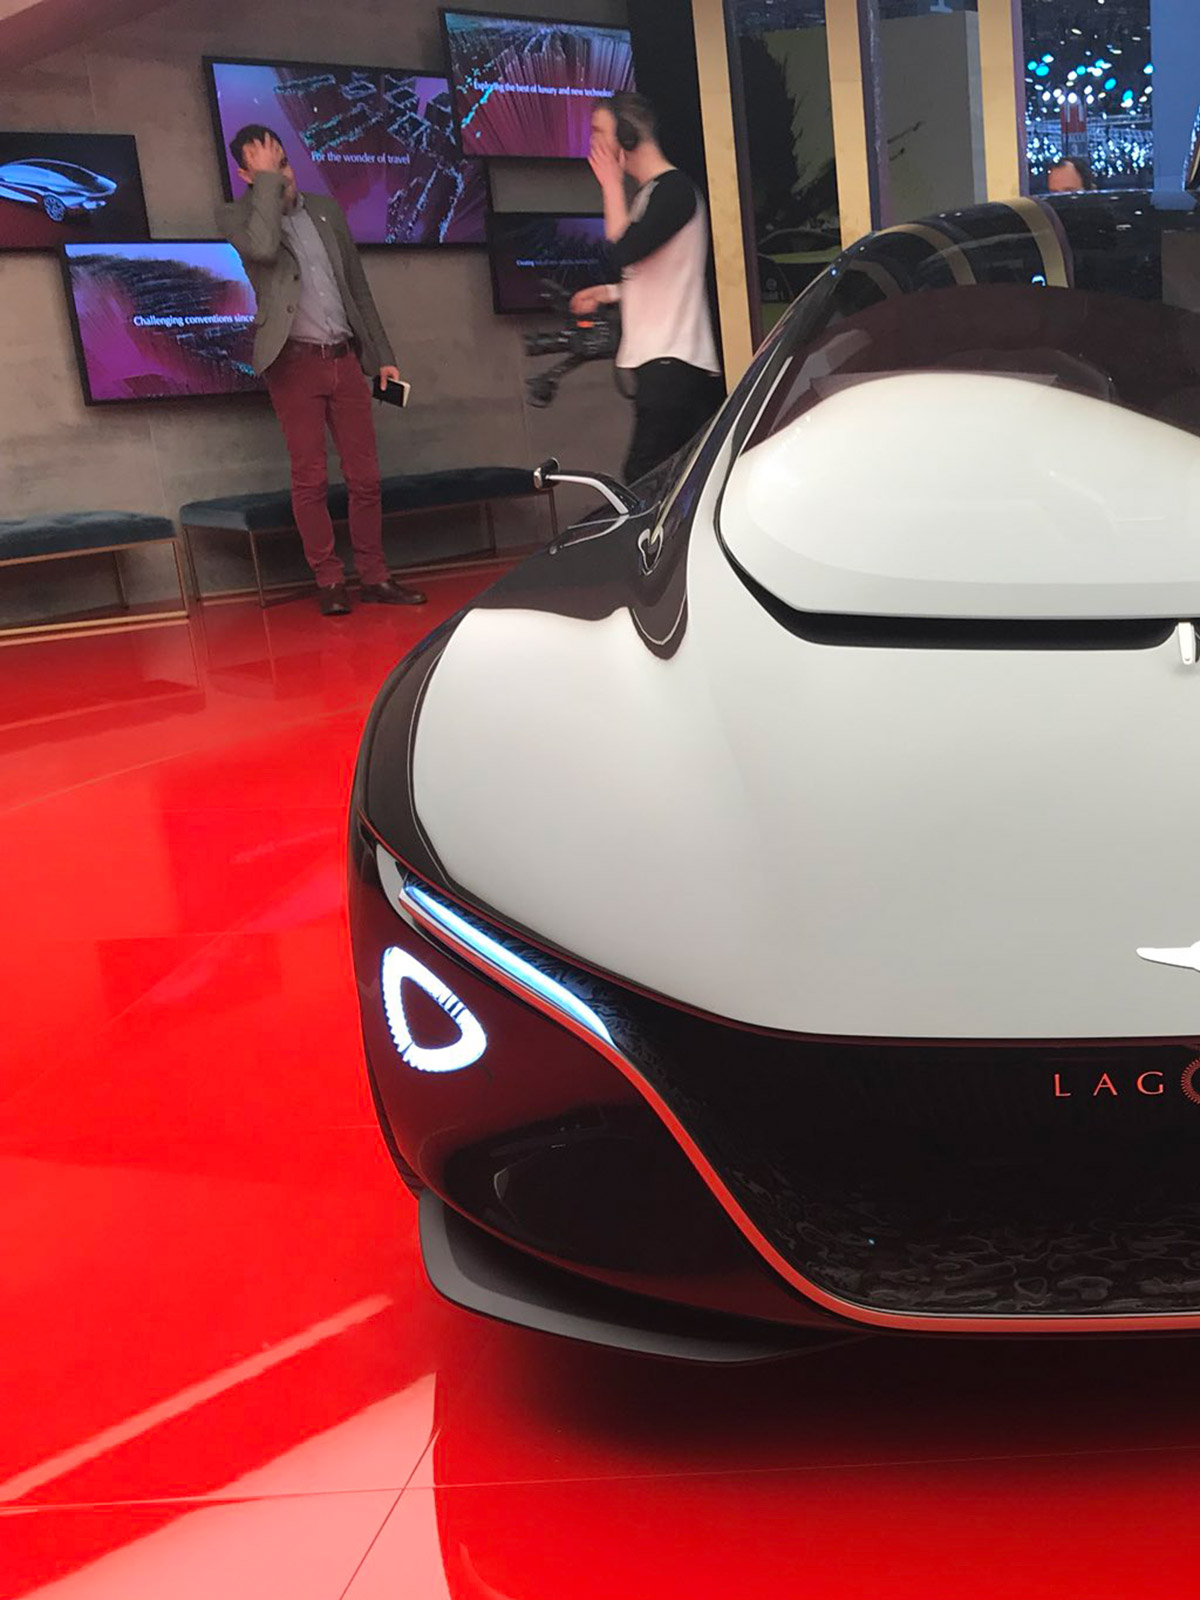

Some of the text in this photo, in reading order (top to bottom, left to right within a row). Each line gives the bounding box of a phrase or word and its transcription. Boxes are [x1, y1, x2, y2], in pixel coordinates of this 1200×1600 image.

[559, 86, 570, 95] and
[311, 151, 410, 164] For the wonder of travel
[133, 313, 255, 327] Challenging conventions since
